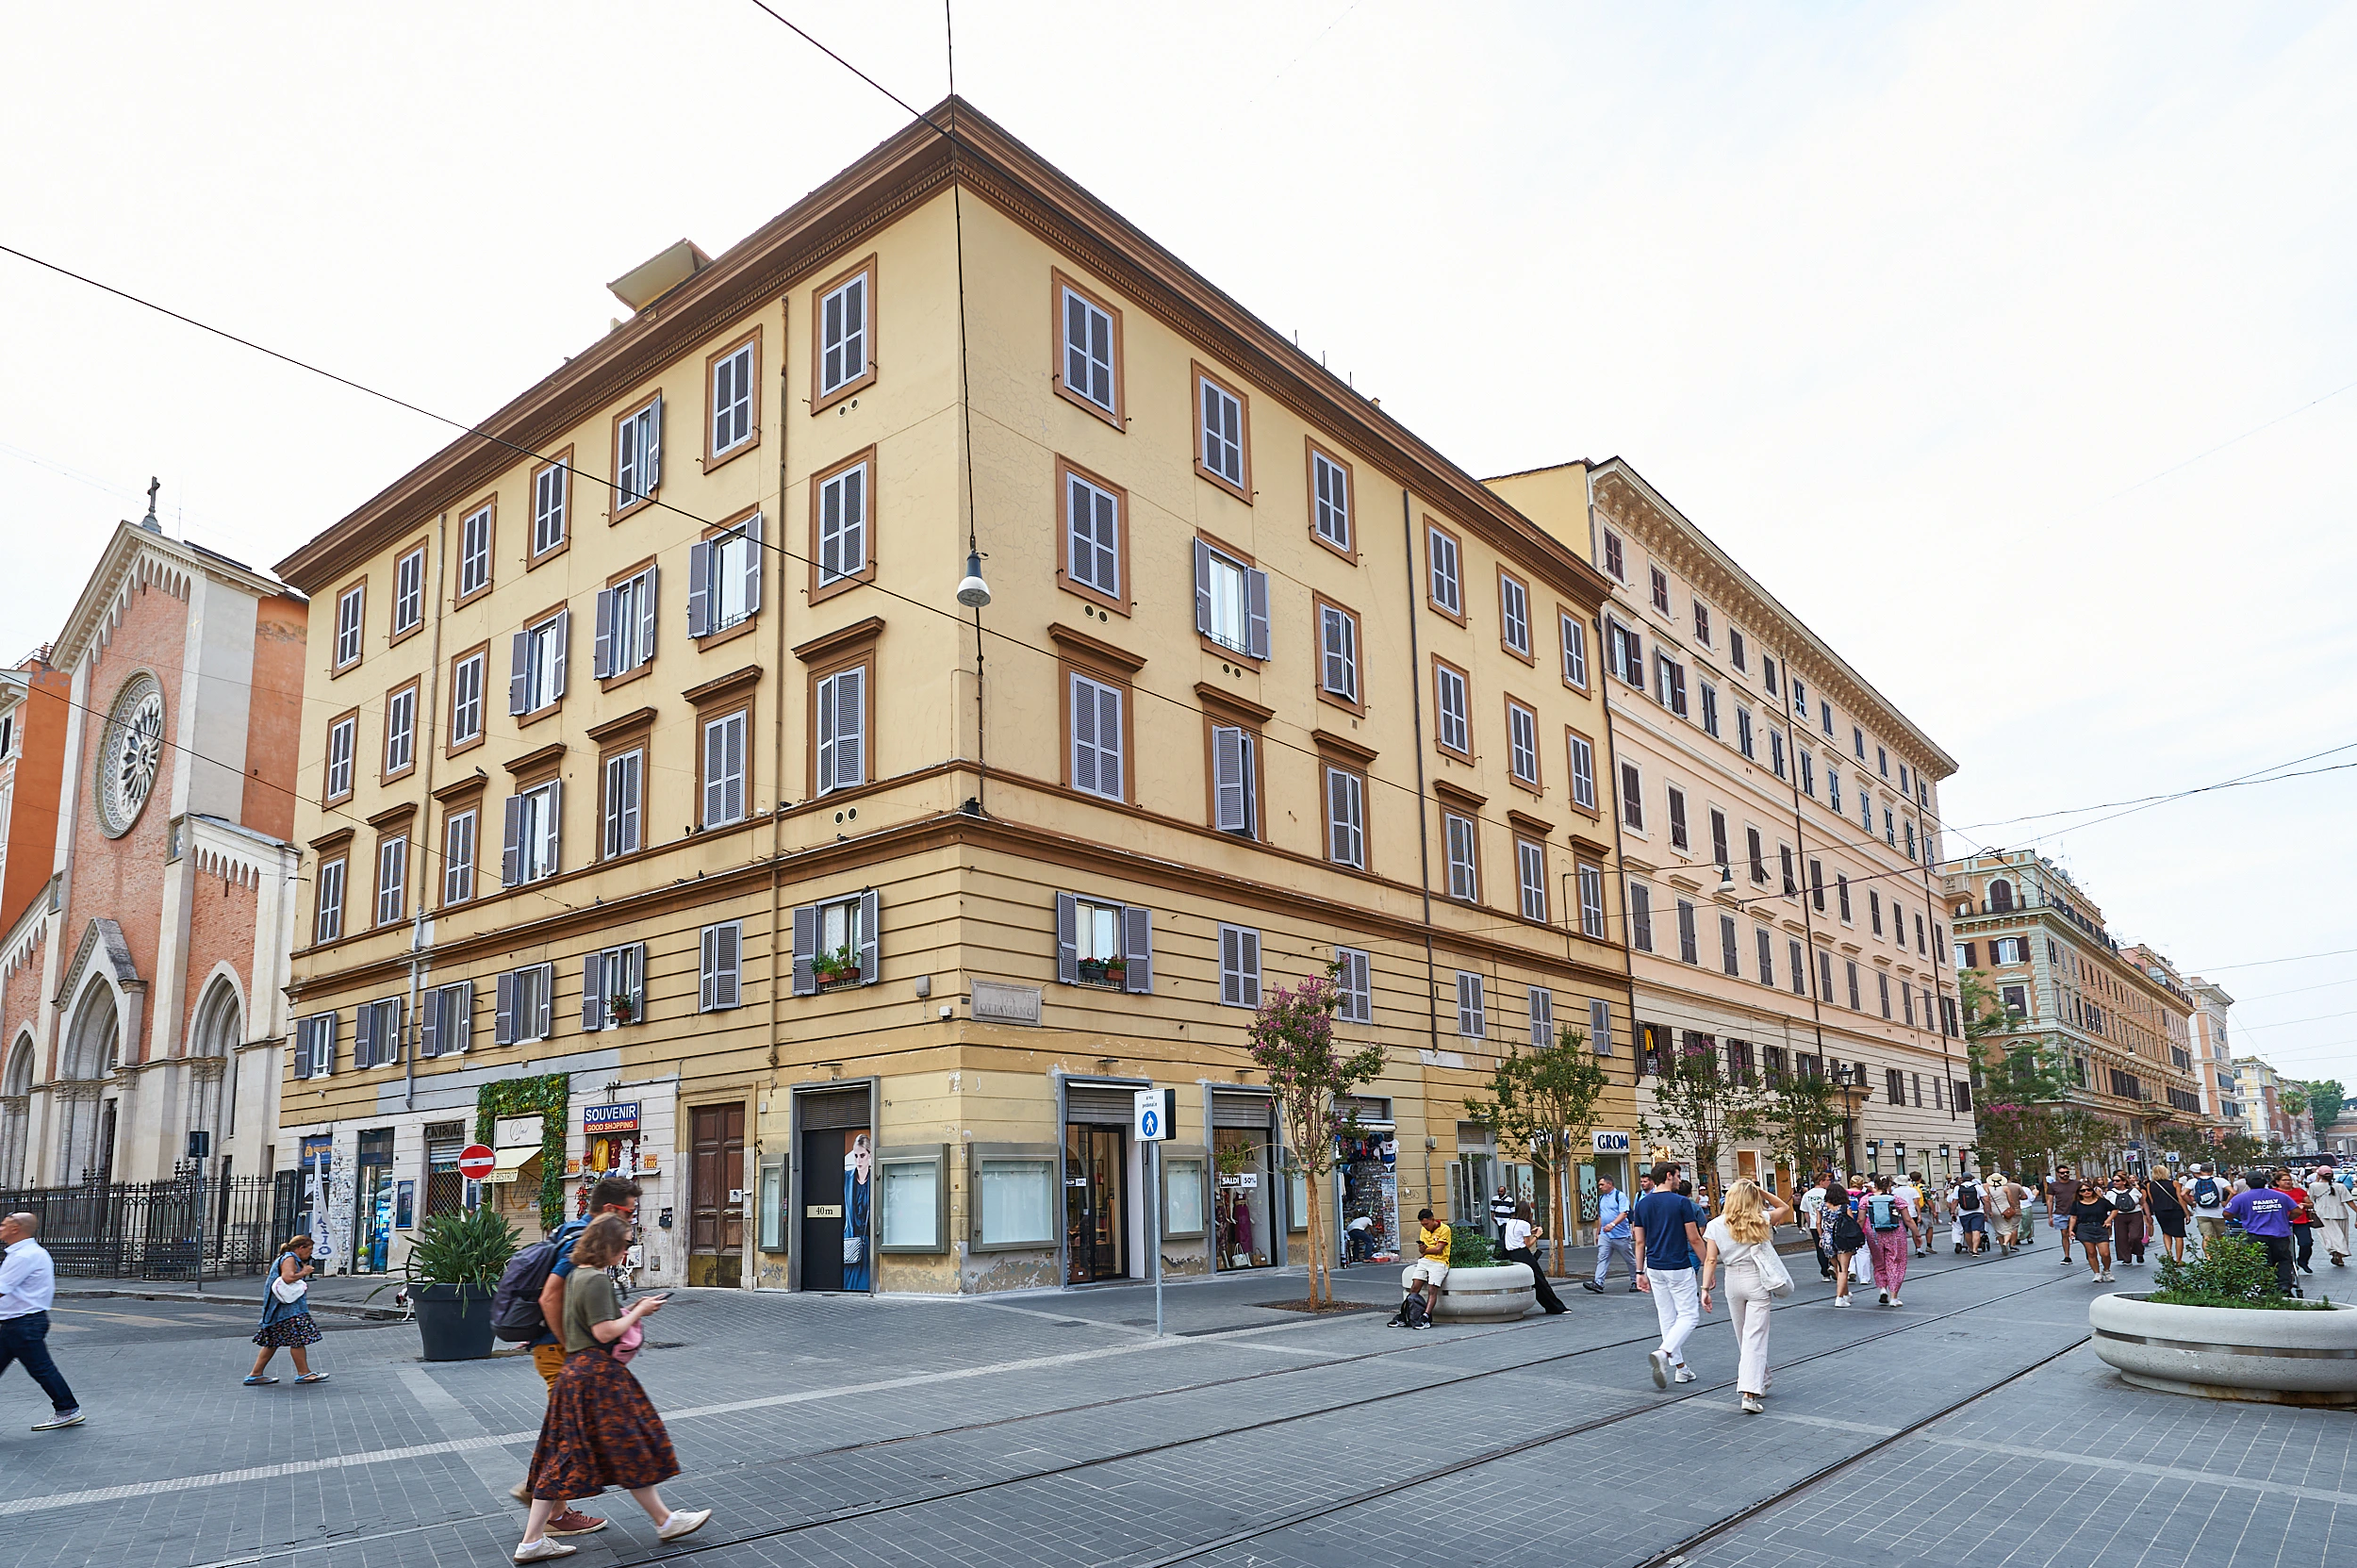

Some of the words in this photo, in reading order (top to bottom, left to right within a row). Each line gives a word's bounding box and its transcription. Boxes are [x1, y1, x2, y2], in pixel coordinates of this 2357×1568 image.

[981, 1003, 1033, 1016] OTTAVIANO
[585, 1105, 636, 1122] SOUVENIR
[424, 1122, 465, 1139] CINEMA
[586, 1123, 603, 1131] GOOD
[604, 1121, 634, 1130] SHOPPING
[1597, 1134, 1629, 1149] GROM
[496, 1171, 517, 1181] BISTROT
[1222, 1176, 1240, 1185] SALDI
[816, 1206, 833, 1215] 40m
